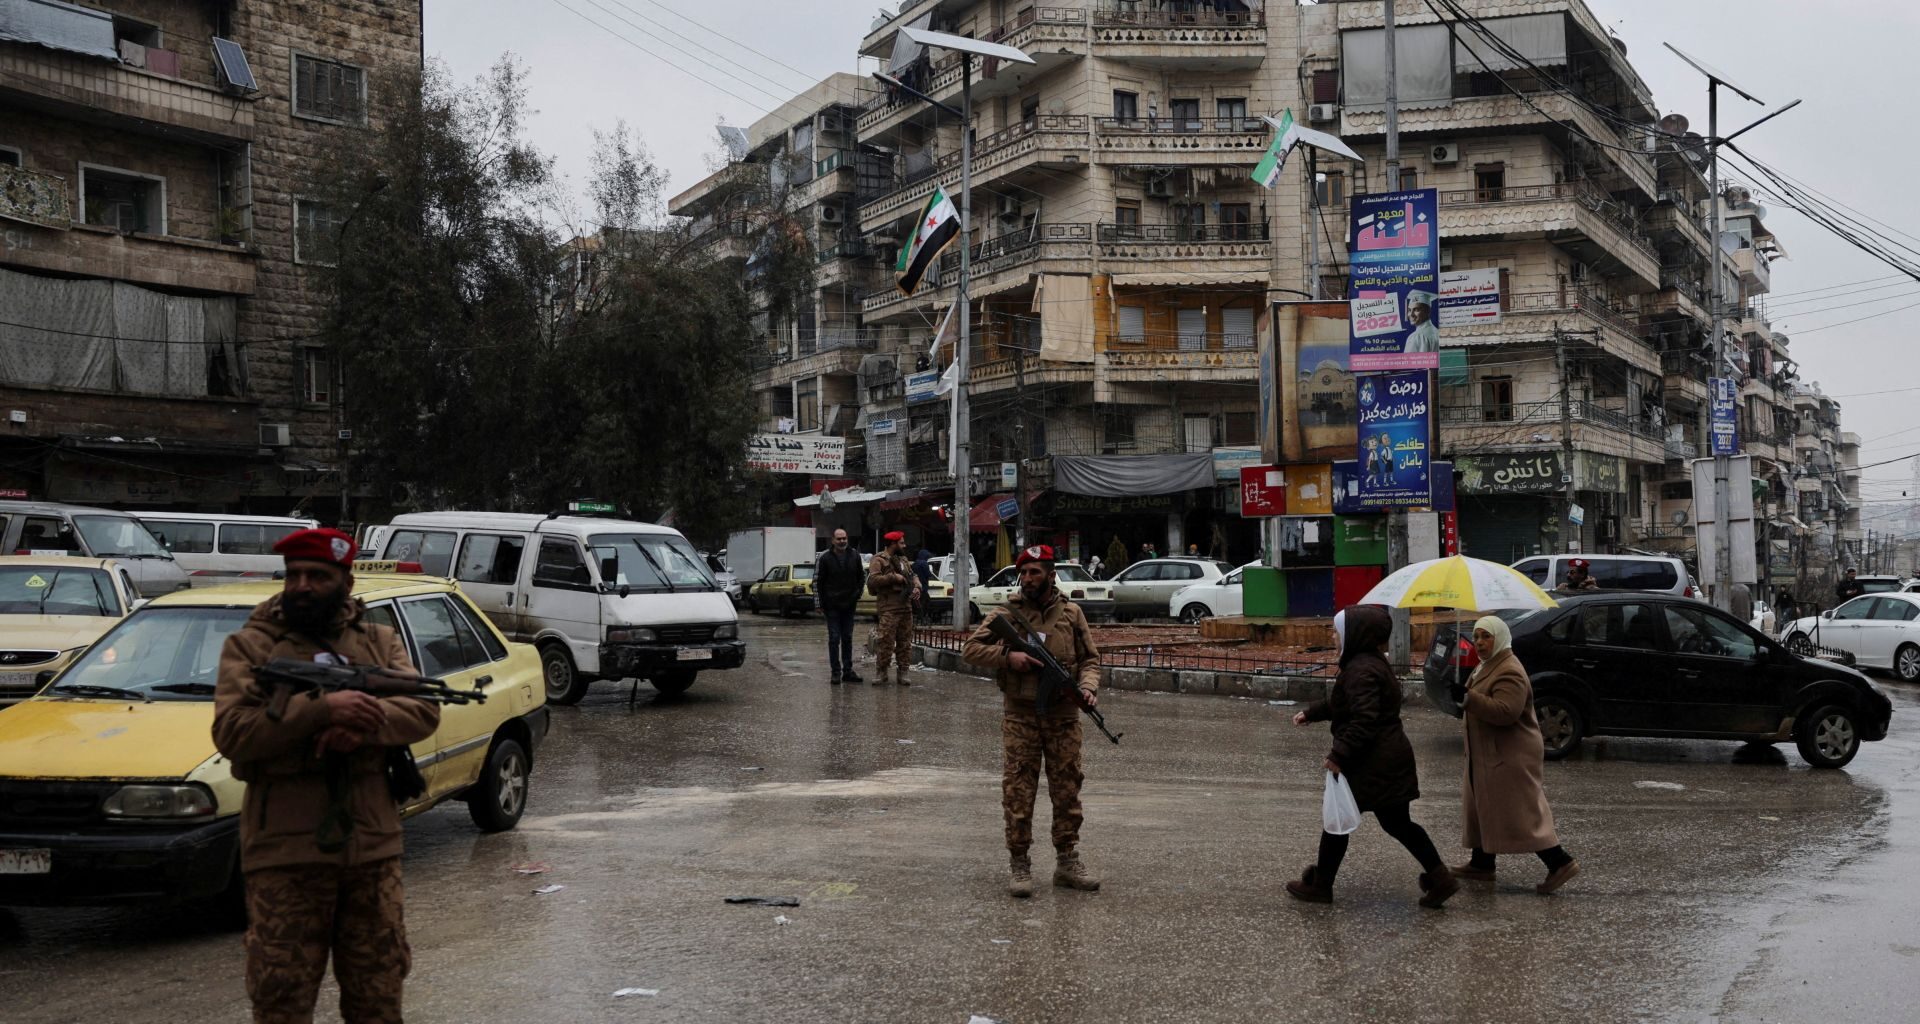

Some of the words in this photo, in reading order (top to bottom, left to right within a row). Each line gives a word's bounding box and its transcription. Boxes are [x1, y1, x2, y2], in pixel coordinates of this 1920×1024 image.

[1377, 209, 1405, 221] معهد
[1357, 201, 1430, 251] فاتنة
[1357, 265, 1381, 275] لدورات
[1381, 263, 1409, 274] التسجيل
[1409, 262, 1431, 275] افتتاح
[1354, 277, 1376, 289] التاسع
[1408, 274, 1434, 286] العلمي
[1441, 274, 1470, 284] الدكتور
[1463, 285, 1478, 295] عبد
[1356, 300, 1388, 311] التسجيل
[1356, 314, 1398, 332] 2027
[1389, 380, 1423, 396] روضة
[1359, 402, 1380, 423] كيدز
[1408, 401, 1426, 420] قطر
[814, 441, 843, 450] Syrian
[1393, 437, 1425, 451] طفلك
[1717, 434, 1732, 446] 2027
[814, 452, 842, 460] iNova
[1399, 451, 1423, 469] بأمان
[1493, 457, 1553, 484] تاتش
